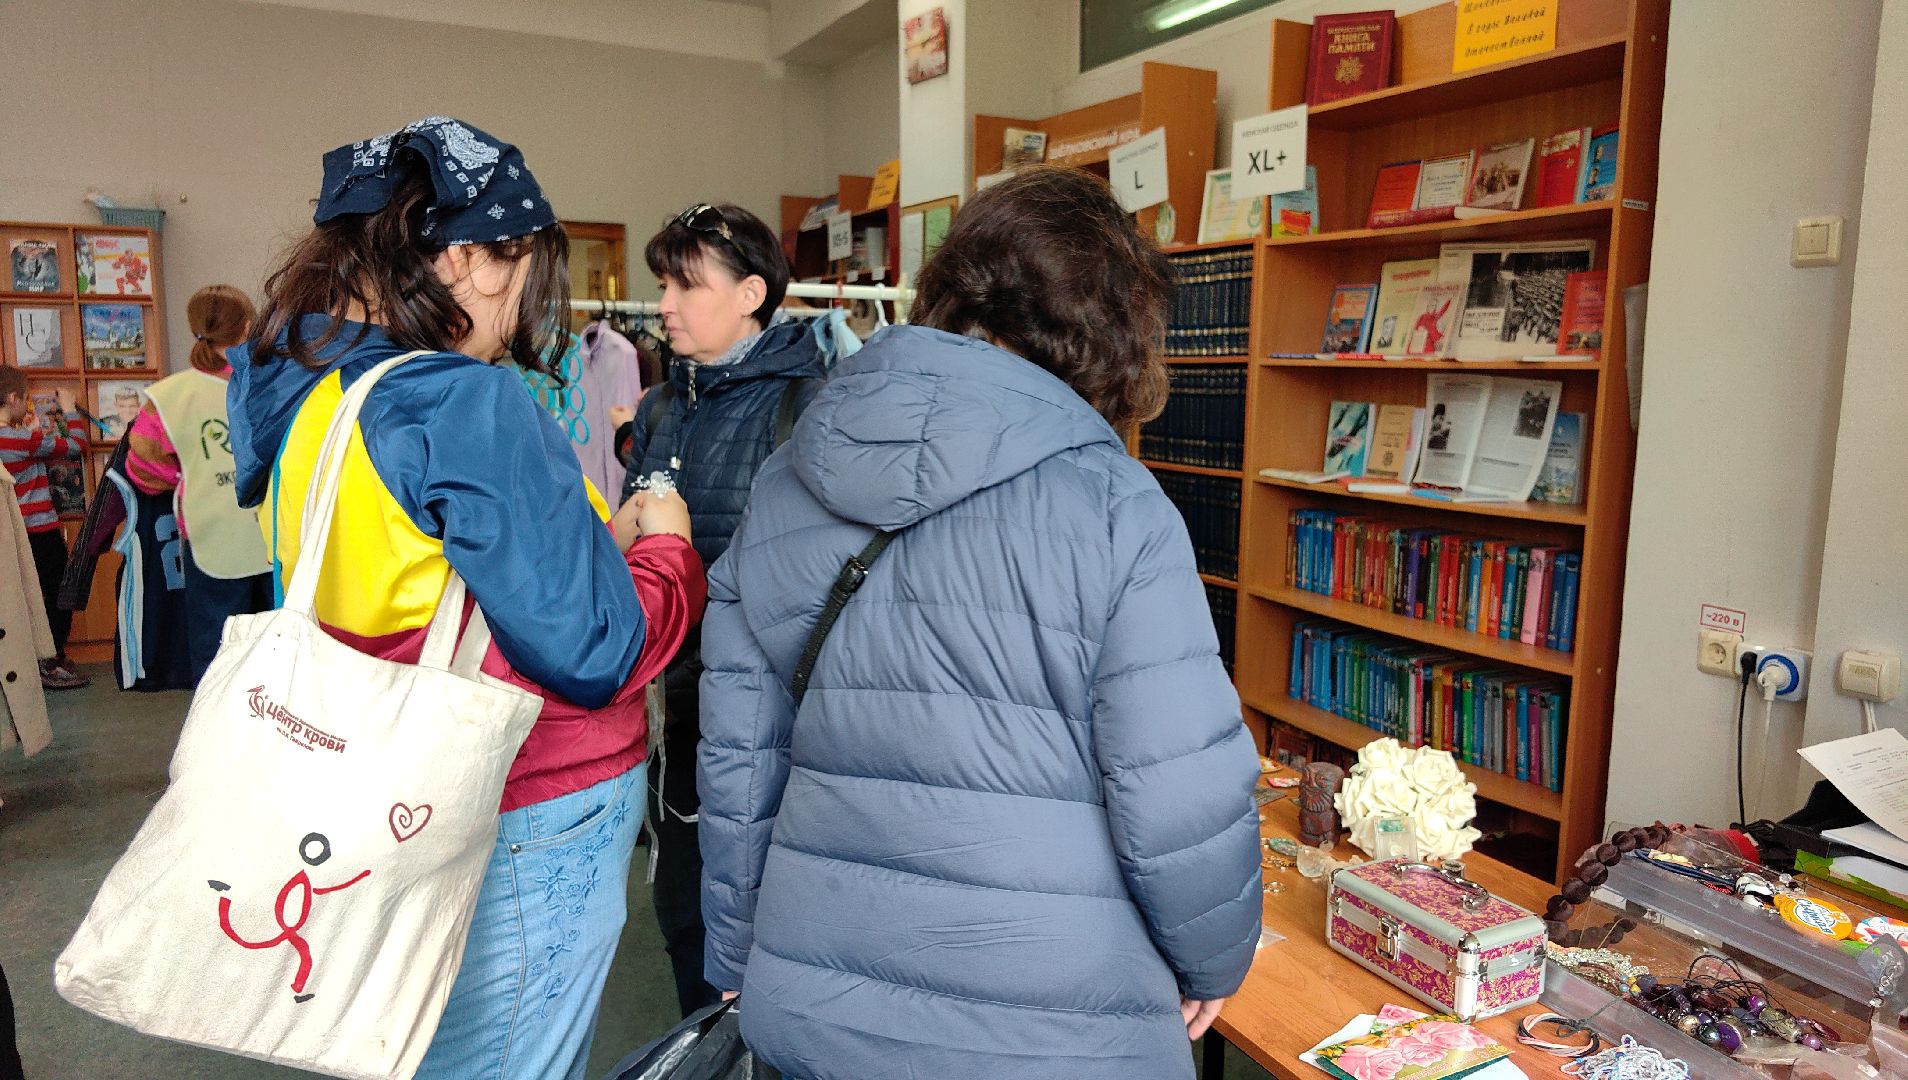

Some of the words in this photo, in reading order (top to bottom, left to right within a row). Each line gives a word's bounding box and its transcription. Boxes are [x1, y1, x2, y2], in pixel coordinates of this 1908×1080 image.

[1333, 32, 1371, 44] КНИГА
[1327, 42, 1376, 54] ПАМЯТИ
[1248, 149, 1287, 175] XL+
[1134, 170, 1144, 189] L
[266, 701, 303, 735] Центр
[303, 727, 346, 754] крови
